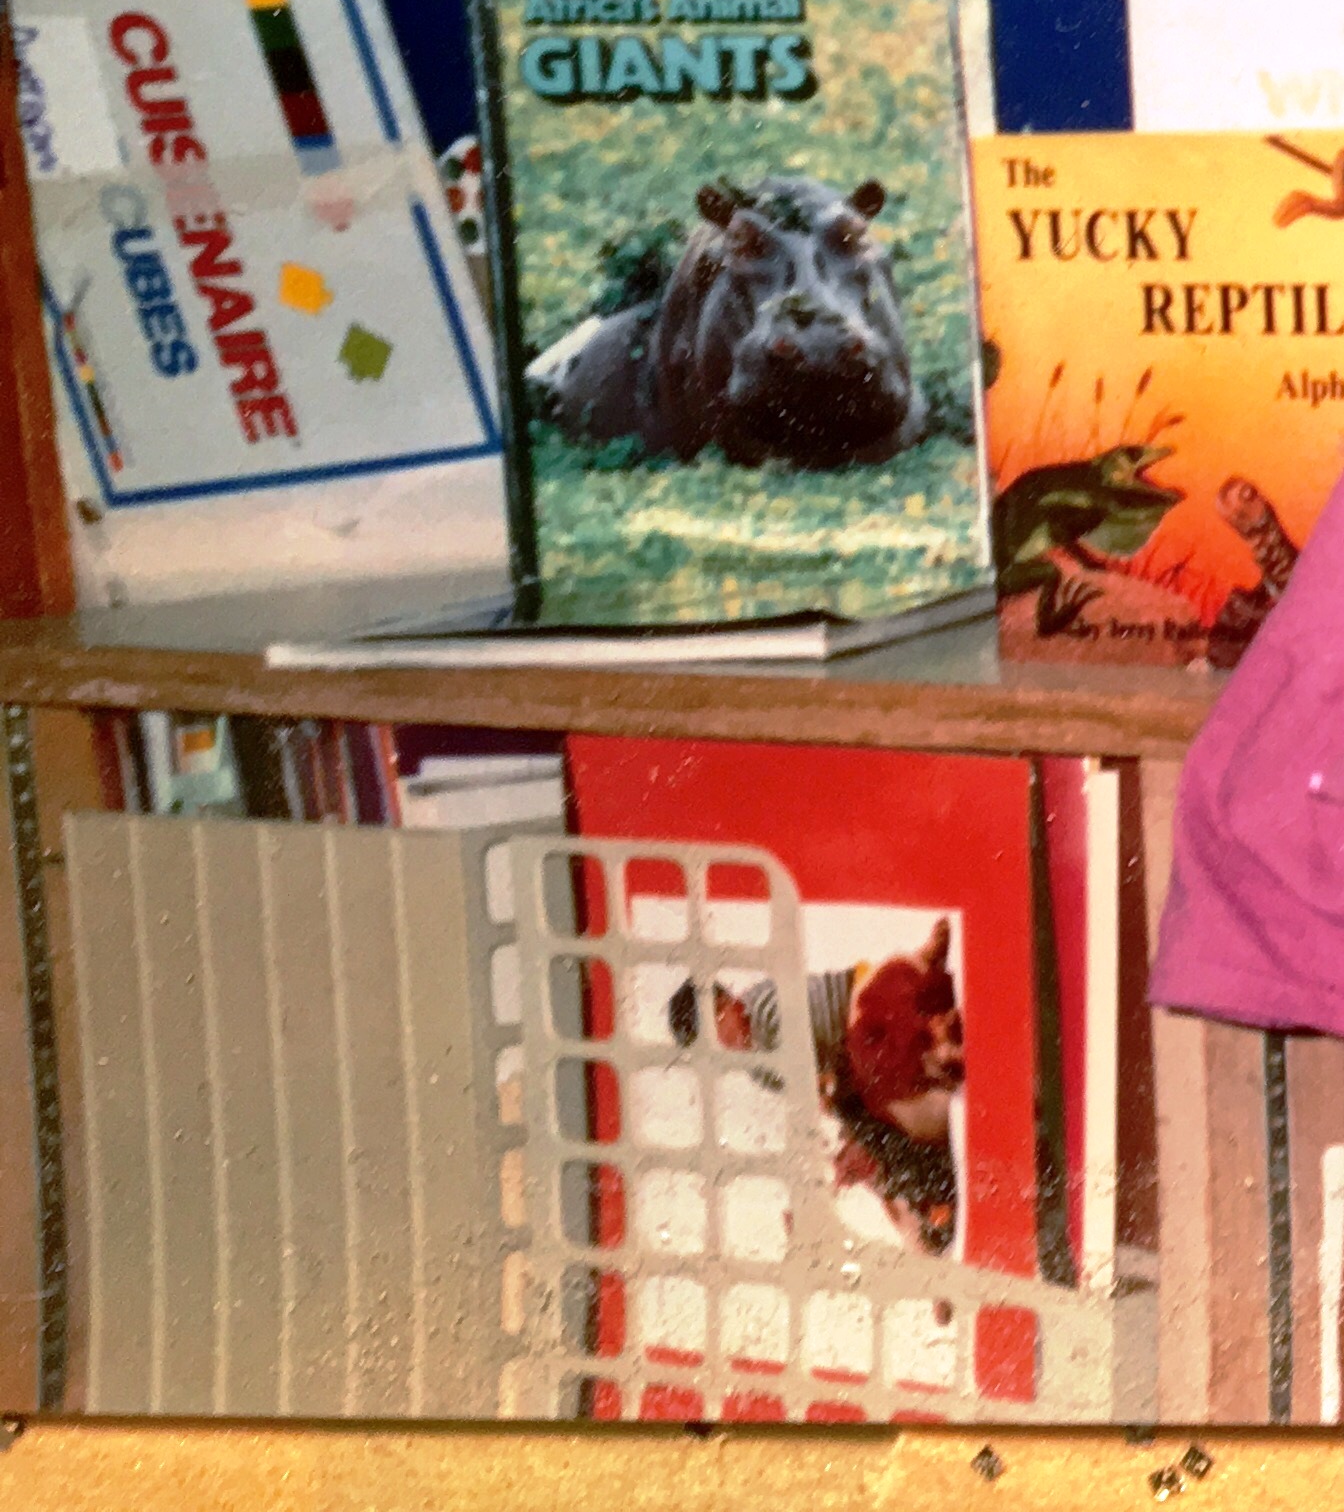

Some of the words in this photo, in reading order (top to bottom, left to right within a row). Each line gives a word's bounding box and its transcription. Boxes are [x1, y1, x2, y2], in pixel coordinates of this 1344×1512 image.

[520, 34, 815, 99] GIANTS
[1002, 157, 1056, 188] The
[1005, 208, 1198, 263] YUCKY
[99, 186, 200, 380] CUBES
